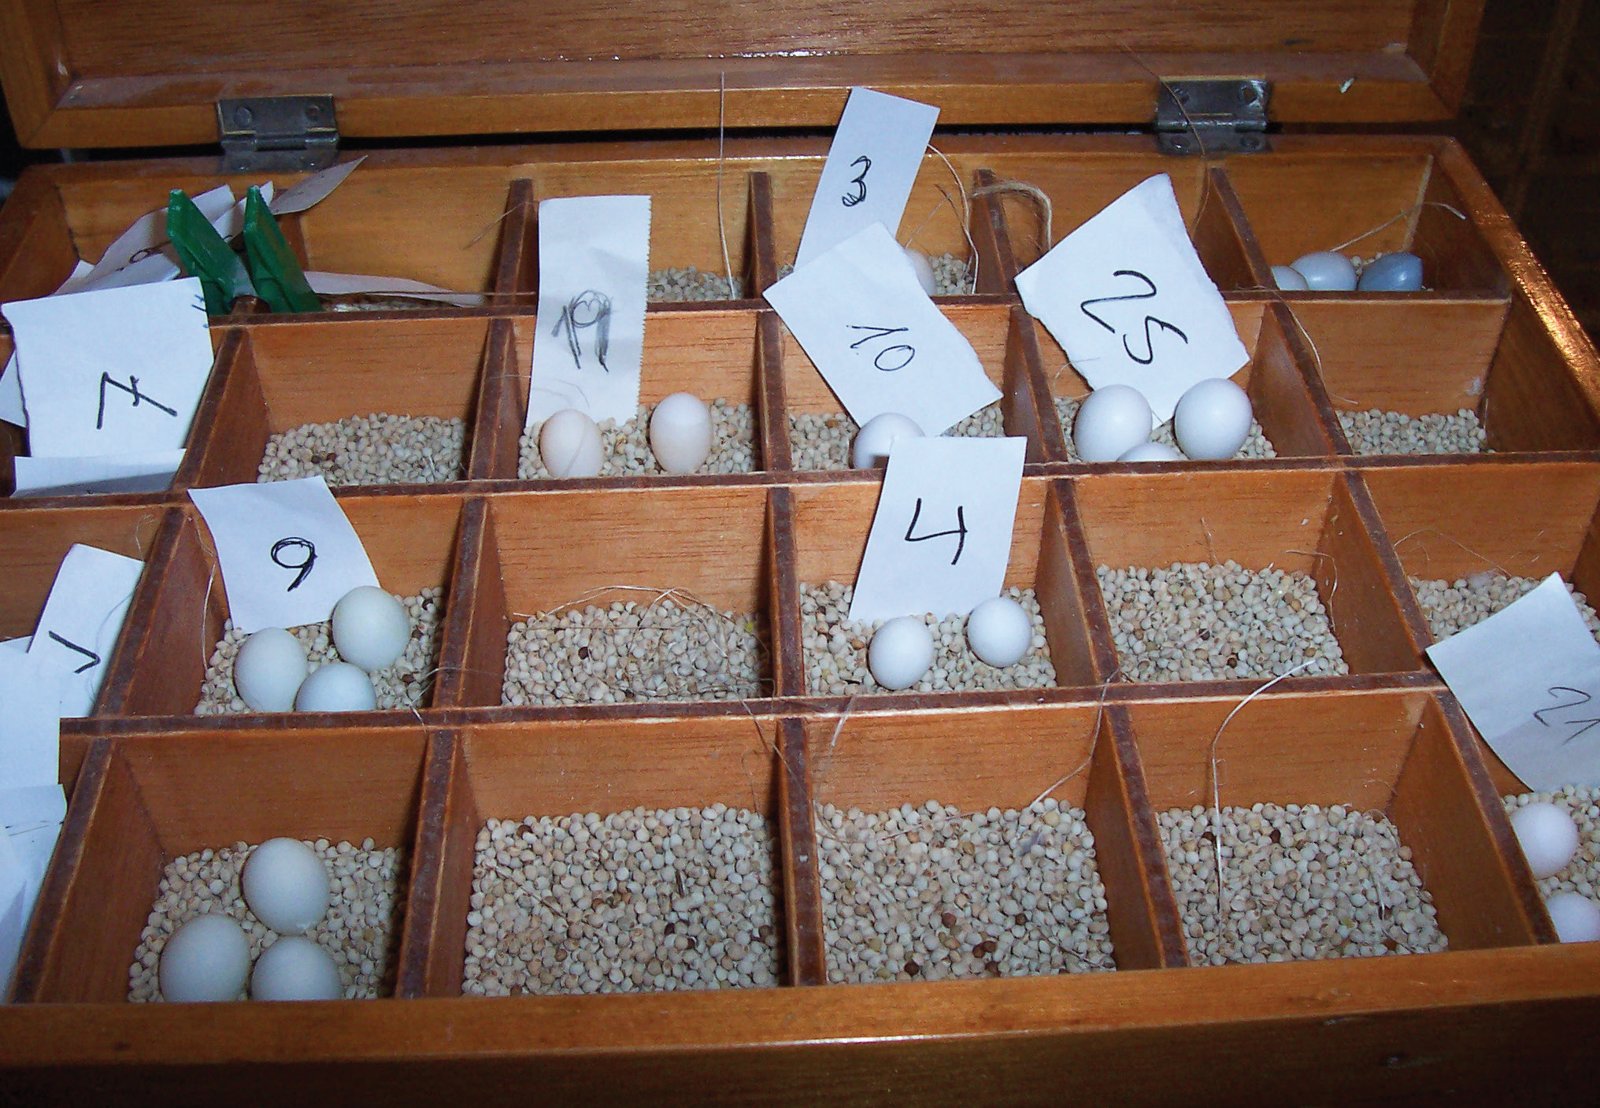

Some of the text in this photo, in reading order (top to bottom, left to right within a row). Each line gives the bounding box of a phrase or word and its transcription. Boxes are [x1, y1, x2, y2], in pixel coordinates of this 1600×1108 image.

[842, 156, 871, 207] 3
[1081, 270, 1189, 365] 25
[905, 498, 968, 566] 4
[271, 537, 318, 591] 9
